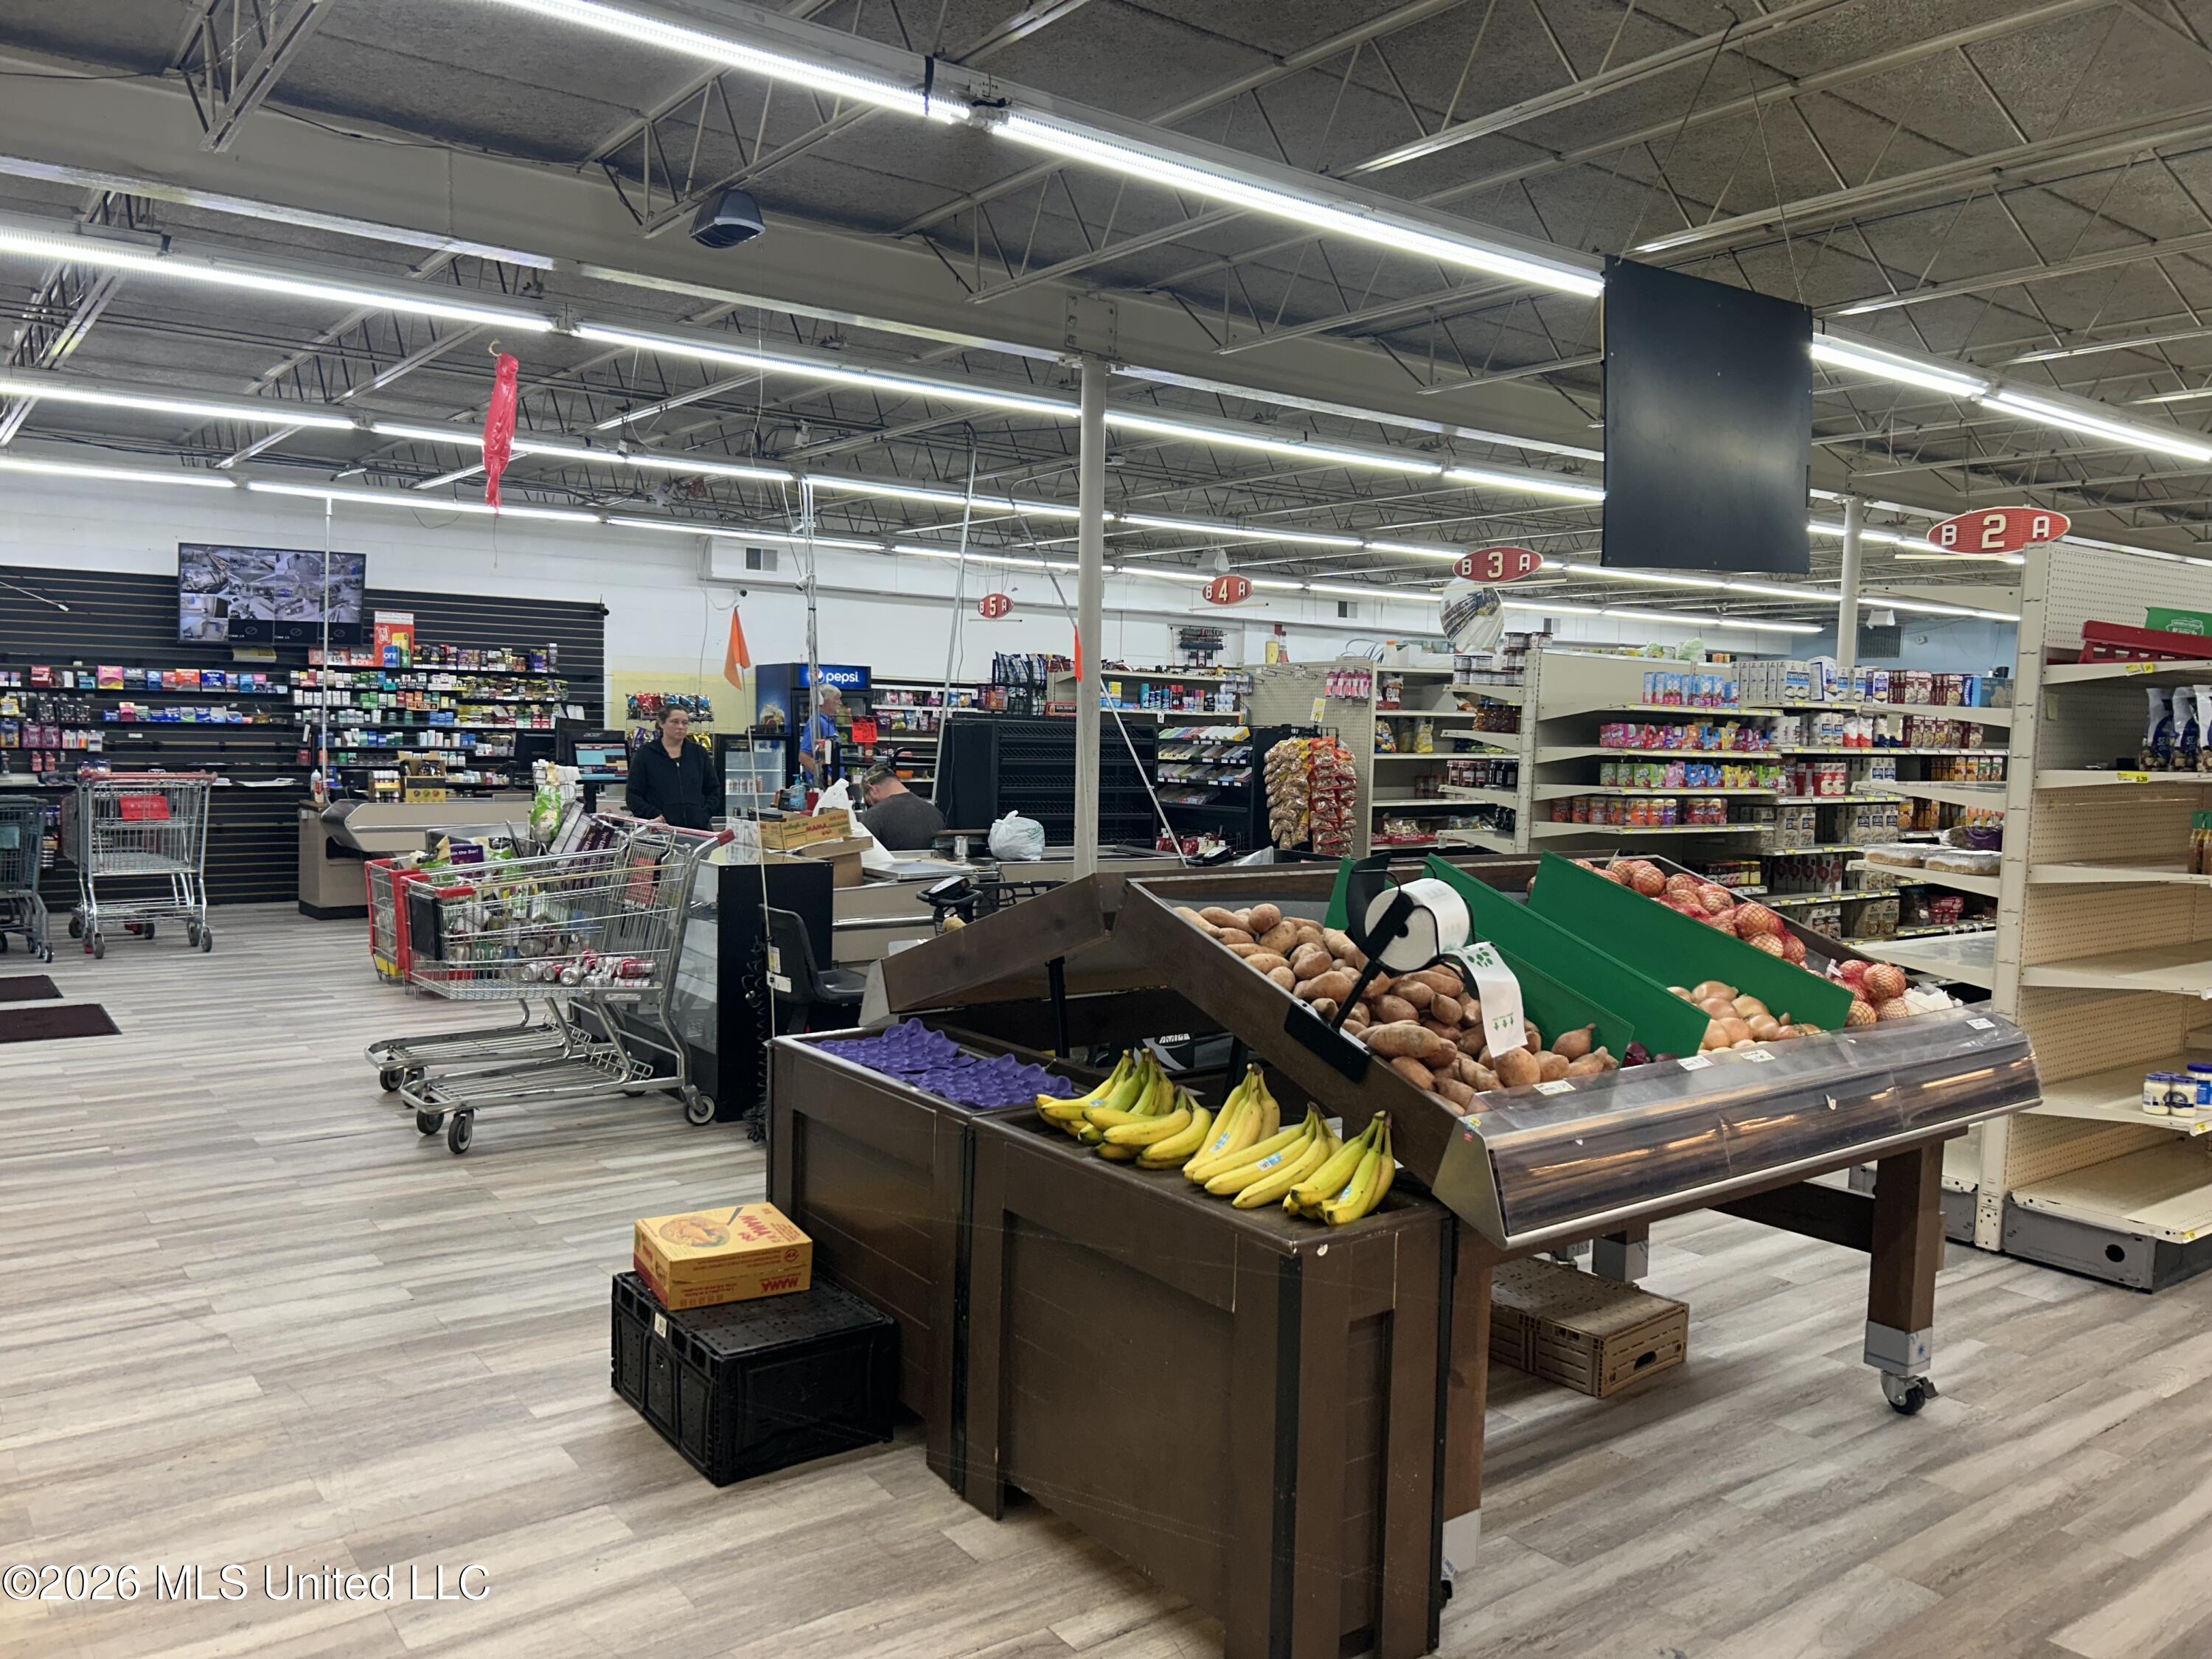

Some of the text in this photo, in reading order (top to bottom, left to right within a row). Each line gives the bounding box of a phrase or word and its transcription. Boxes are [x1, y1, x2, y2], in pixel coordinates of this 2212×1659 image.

[1941, 514, 2050, 549] B 2 A
[1461, 552, 1531, 578] B 3 A
[1206, 579, 1245, 601] B 4 A
[979, 597, 1007, 616] B 5 A
[826, 672, 858, 684] pepsi
